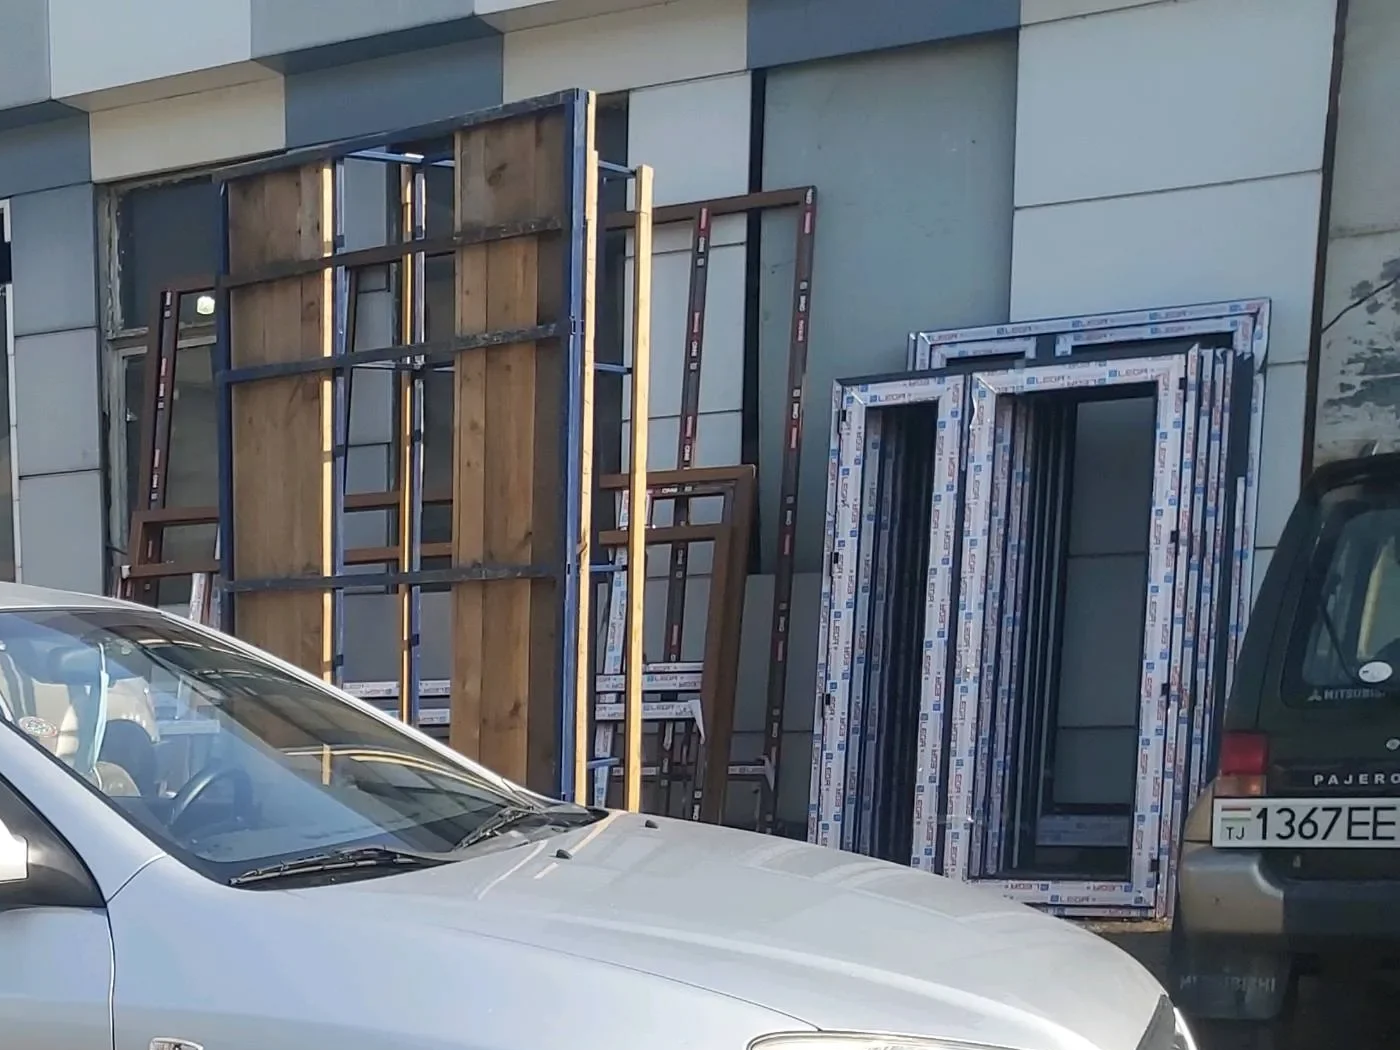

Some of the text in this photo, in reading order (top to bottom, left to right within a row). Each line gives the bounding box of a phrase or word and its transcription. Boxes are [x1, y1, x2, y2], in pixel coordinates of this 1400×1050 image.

[1314, 773, 1400, 786] PAJERO
[1226, 806, 1397, 841] TJ 1367EE
